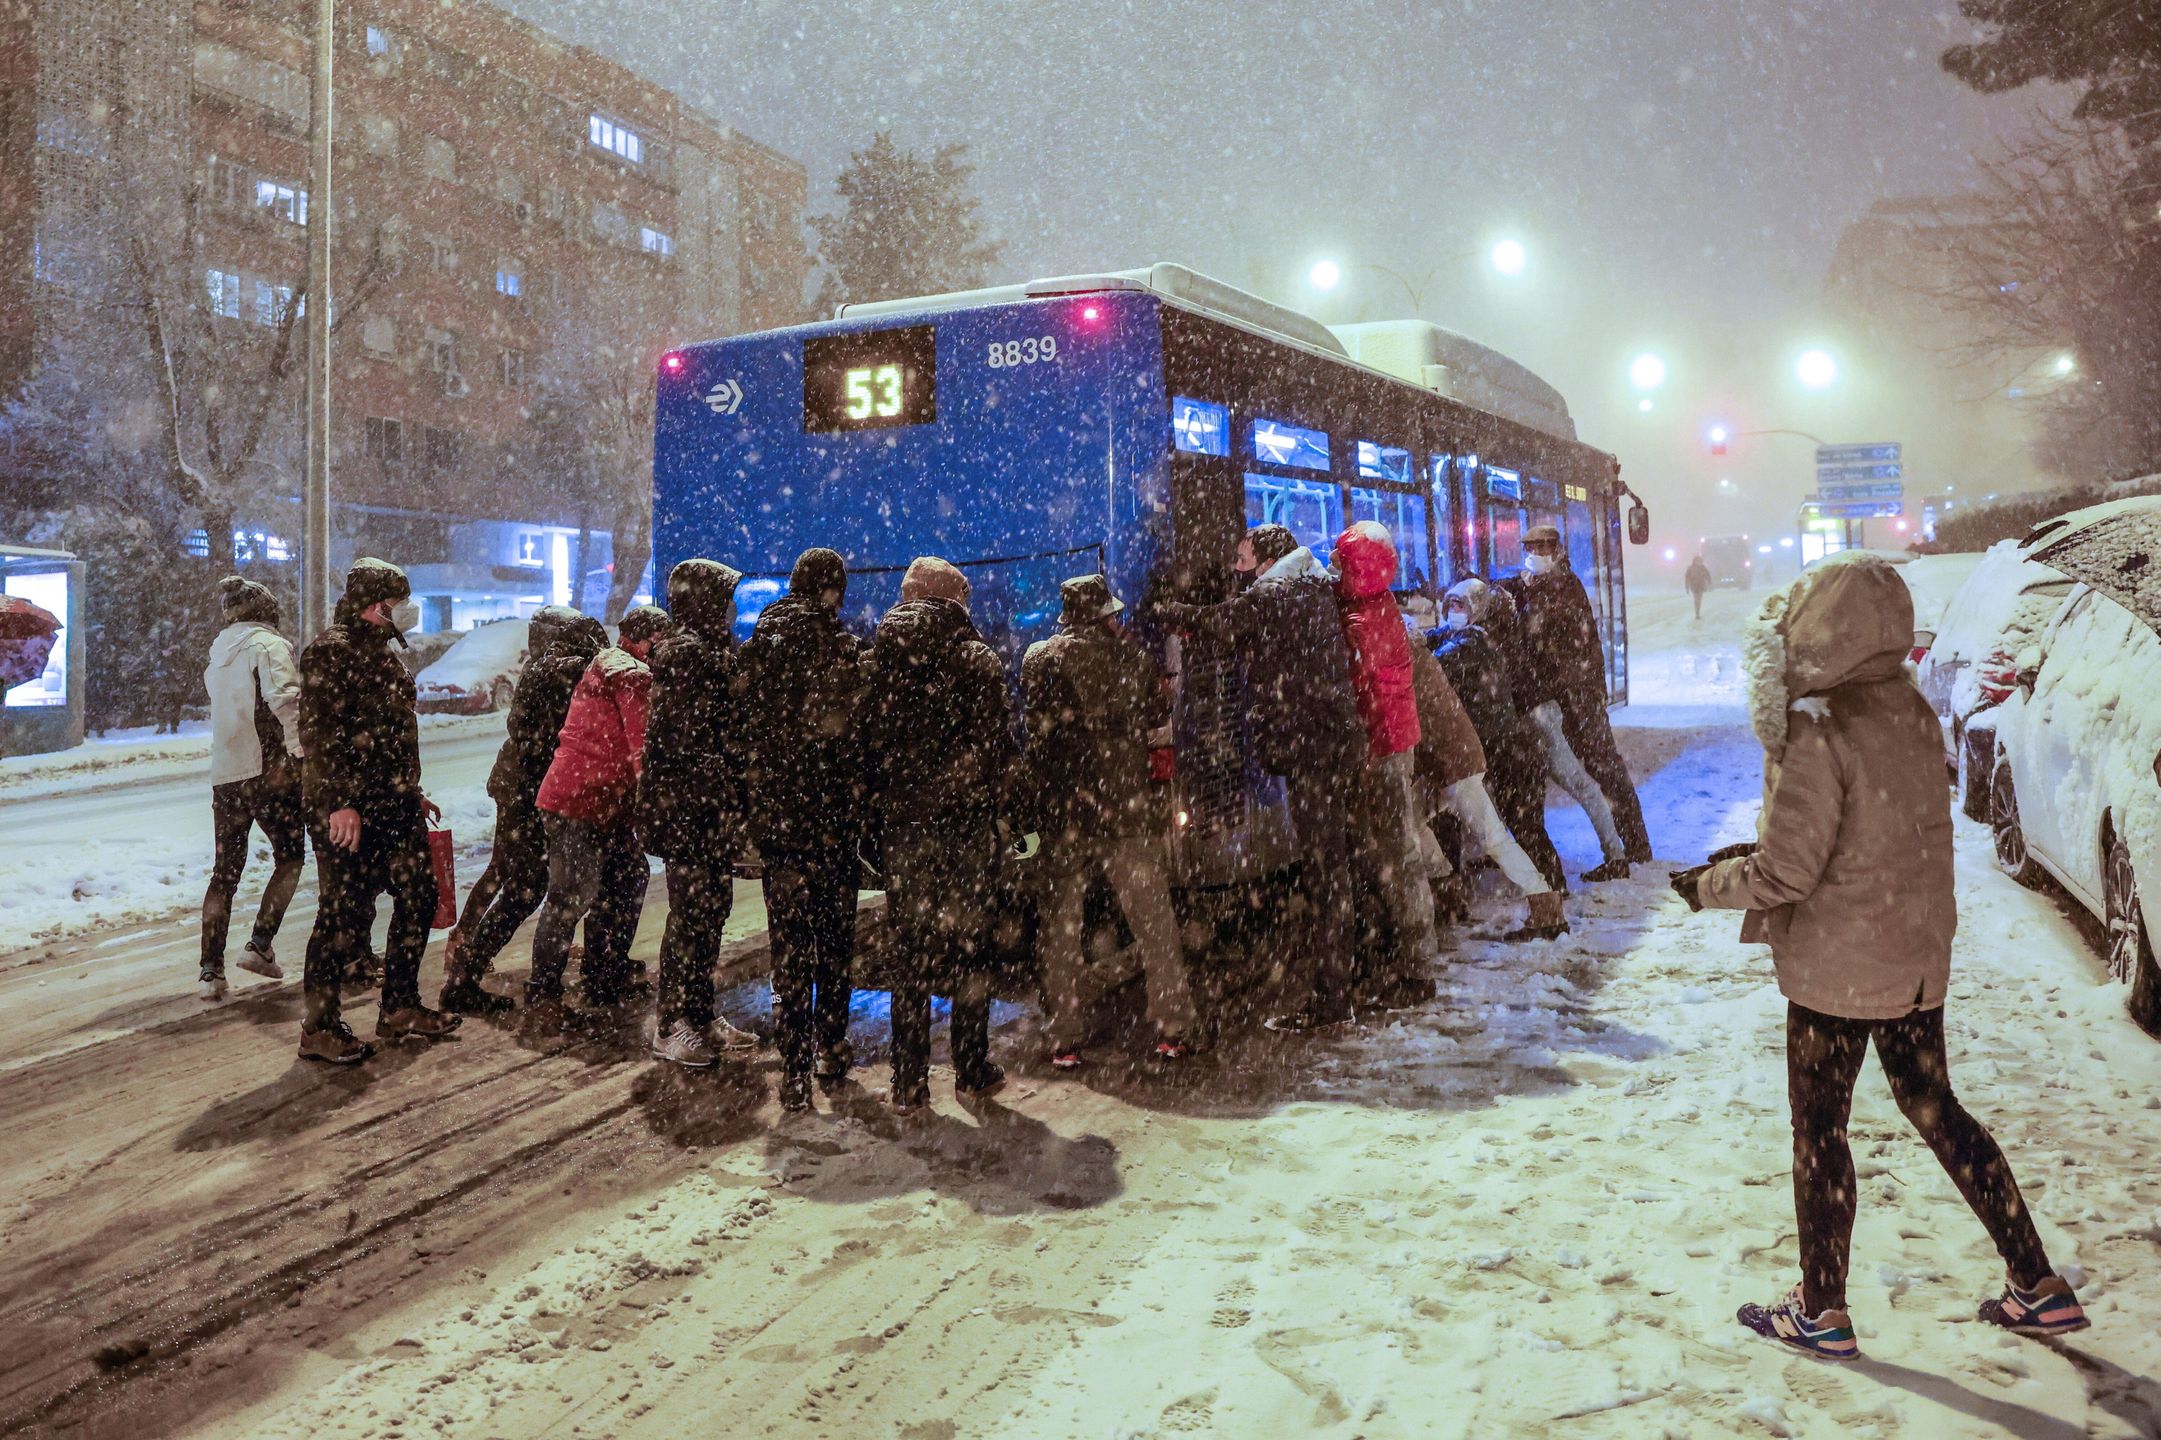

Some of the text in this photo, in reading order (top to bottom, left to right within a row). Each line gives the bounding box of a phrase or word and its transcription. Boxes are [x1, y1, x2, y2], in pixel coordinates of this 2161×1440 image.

[988, 335, 1057, 369] 8839
[846, 365, 902, 420] 53
[1770, 1314, 1799, 1338] N
